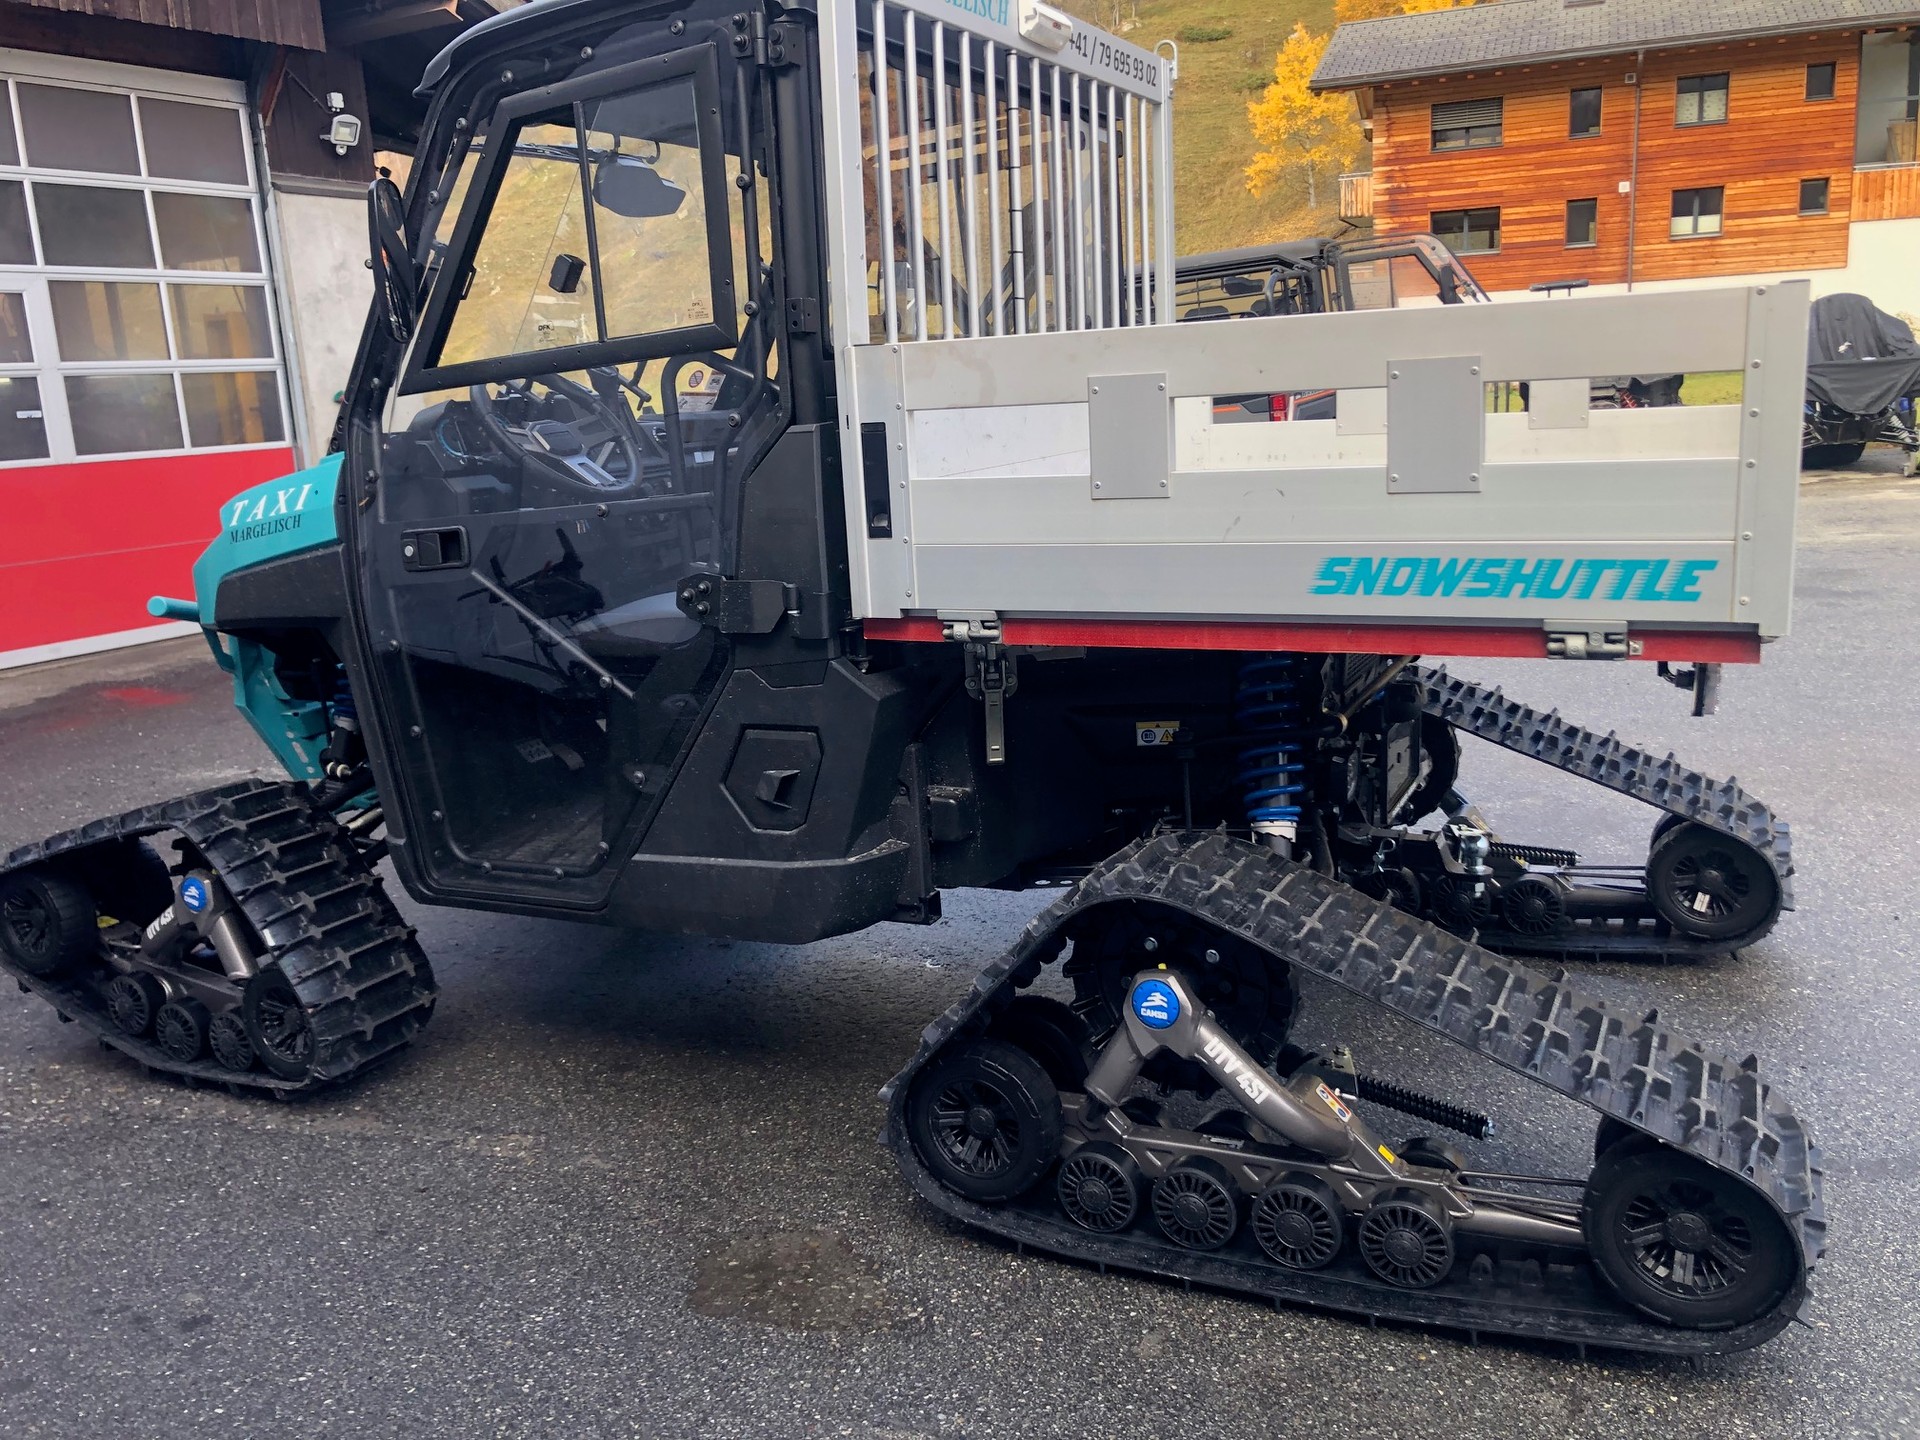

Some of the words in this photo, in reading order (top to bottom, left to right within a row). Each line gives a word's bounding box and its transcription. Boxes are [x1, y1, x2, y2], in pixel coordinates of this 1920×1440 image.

[1069, 32, 1088, 58] +41
[1099, 42, 1112, 67] 79
[1113, 49, 1131, 76] 695
[1132, 57, 1144, 81] 93
[1146, 63, 1157, 87] 02
[229, 483, 313, 527] TAXI
[230, 514, 301, 544] MARGELISCH
[1307, 557, 1719, 601] SNOWSHUTTLE
[1140, 1007, 1168, 1020] CAMSO
[1203, 1036, 1243, 1074] UTV
